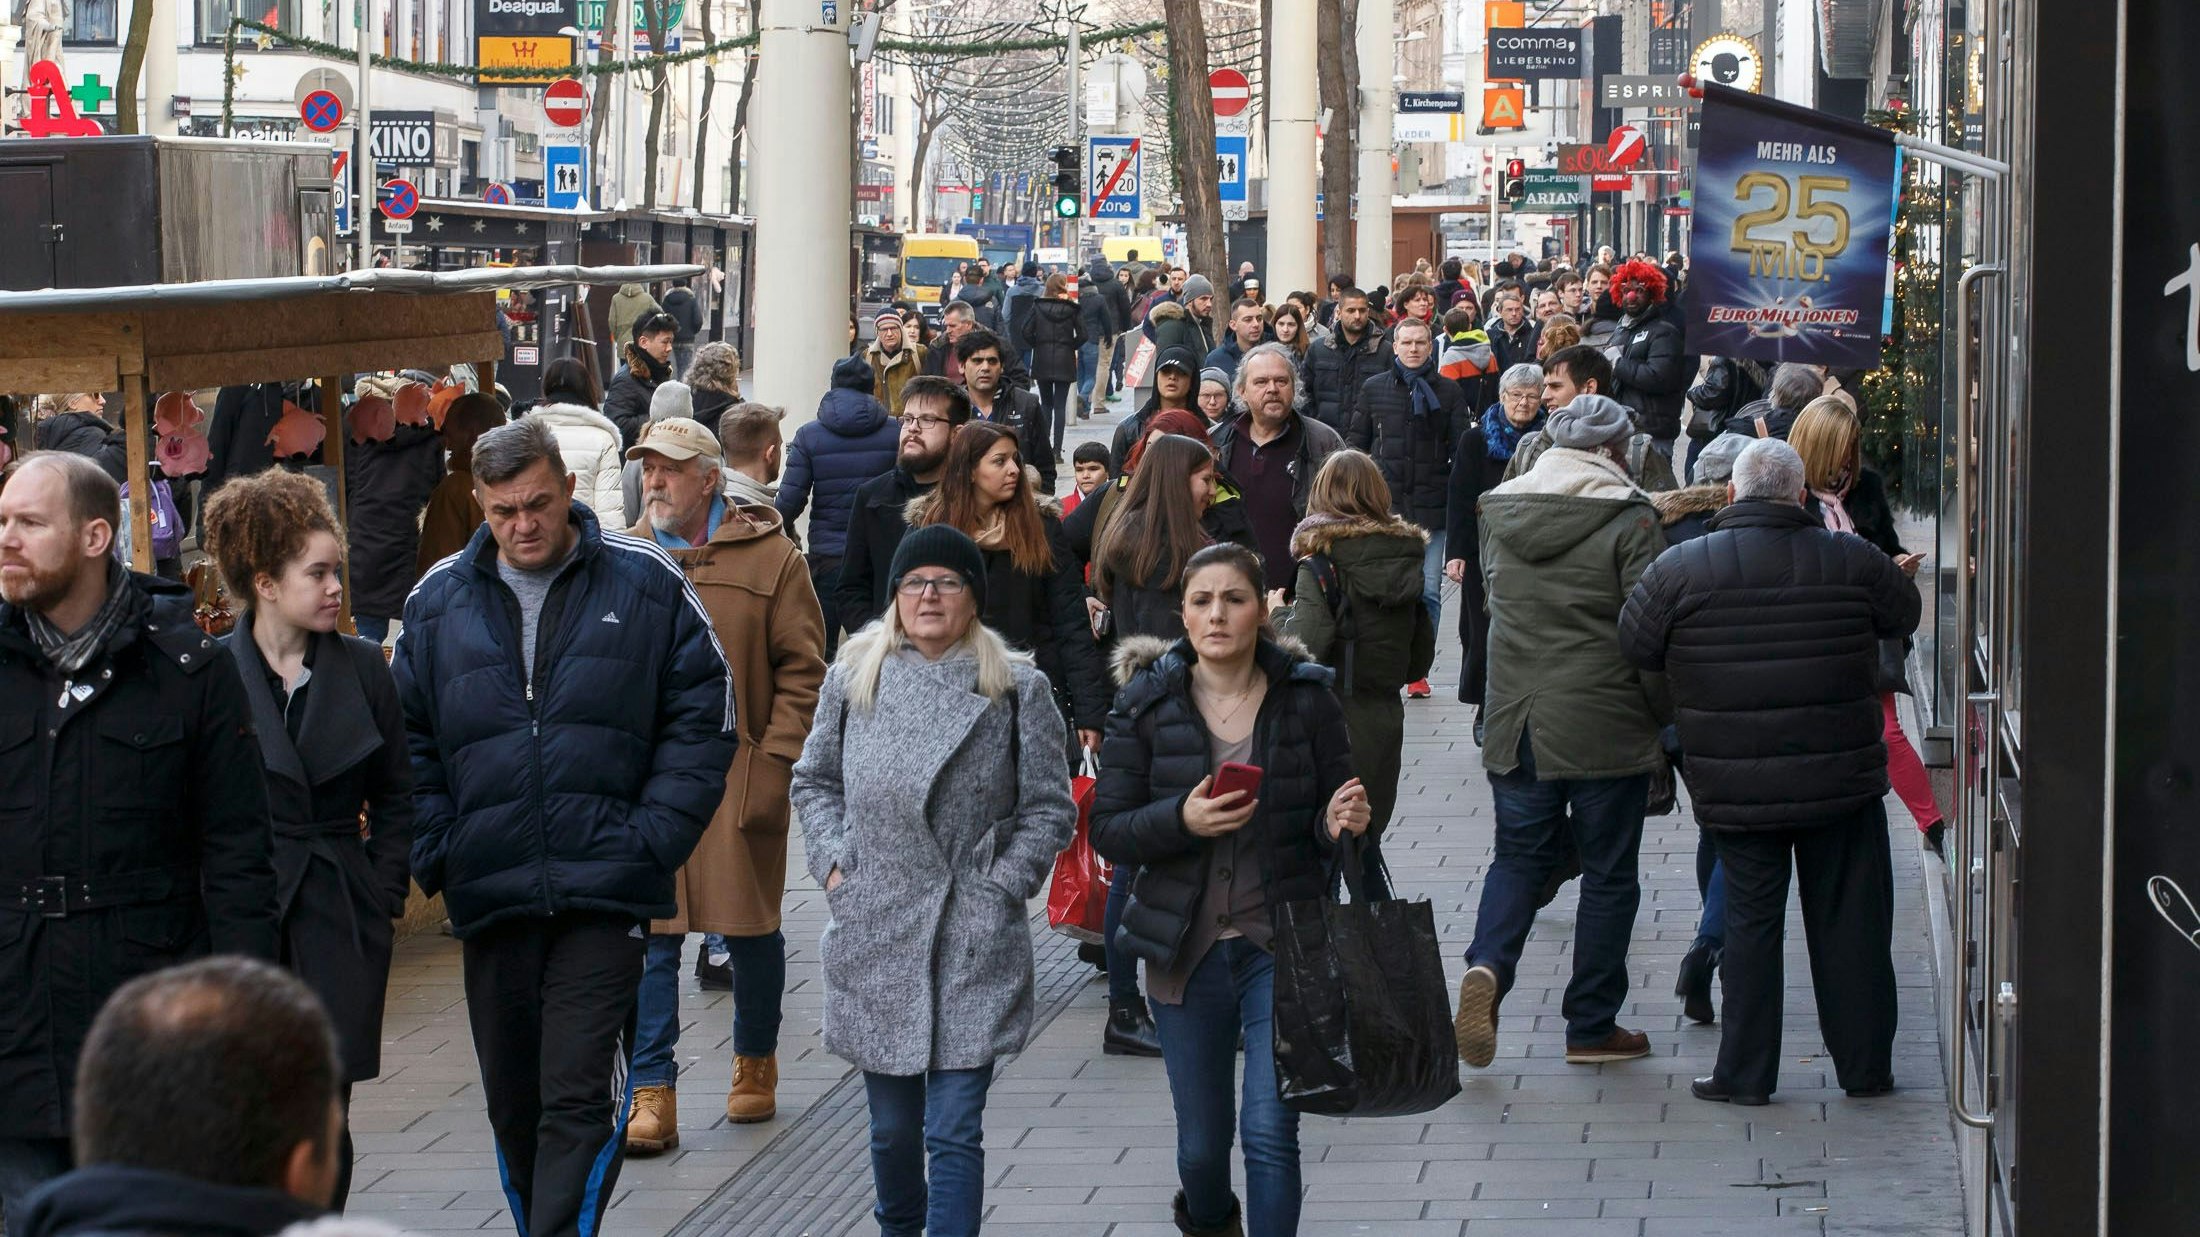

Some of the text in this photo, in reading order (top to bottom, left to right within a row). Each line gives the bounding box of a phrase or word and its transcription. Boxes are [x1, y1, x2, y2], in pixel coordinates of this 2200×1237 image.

[1496, 37, 1576, 52] comma,
[1496, 56, 1576, 65] LIEBESKIND
[1608, 84, 1684, 98] ESPRIT
[1413, 98, 1458, 110] Kirchengasse
[370, 126, 431, 157] KINO
[1398, 129, 1431, 139] LEDER
[1757, 141, 1836, 165] MEHR ALS
[1118, 177, 1134, 192] 20
[1731, 171, 1850, 258] 25
[1750, 244, 1830, 283] MIO.
